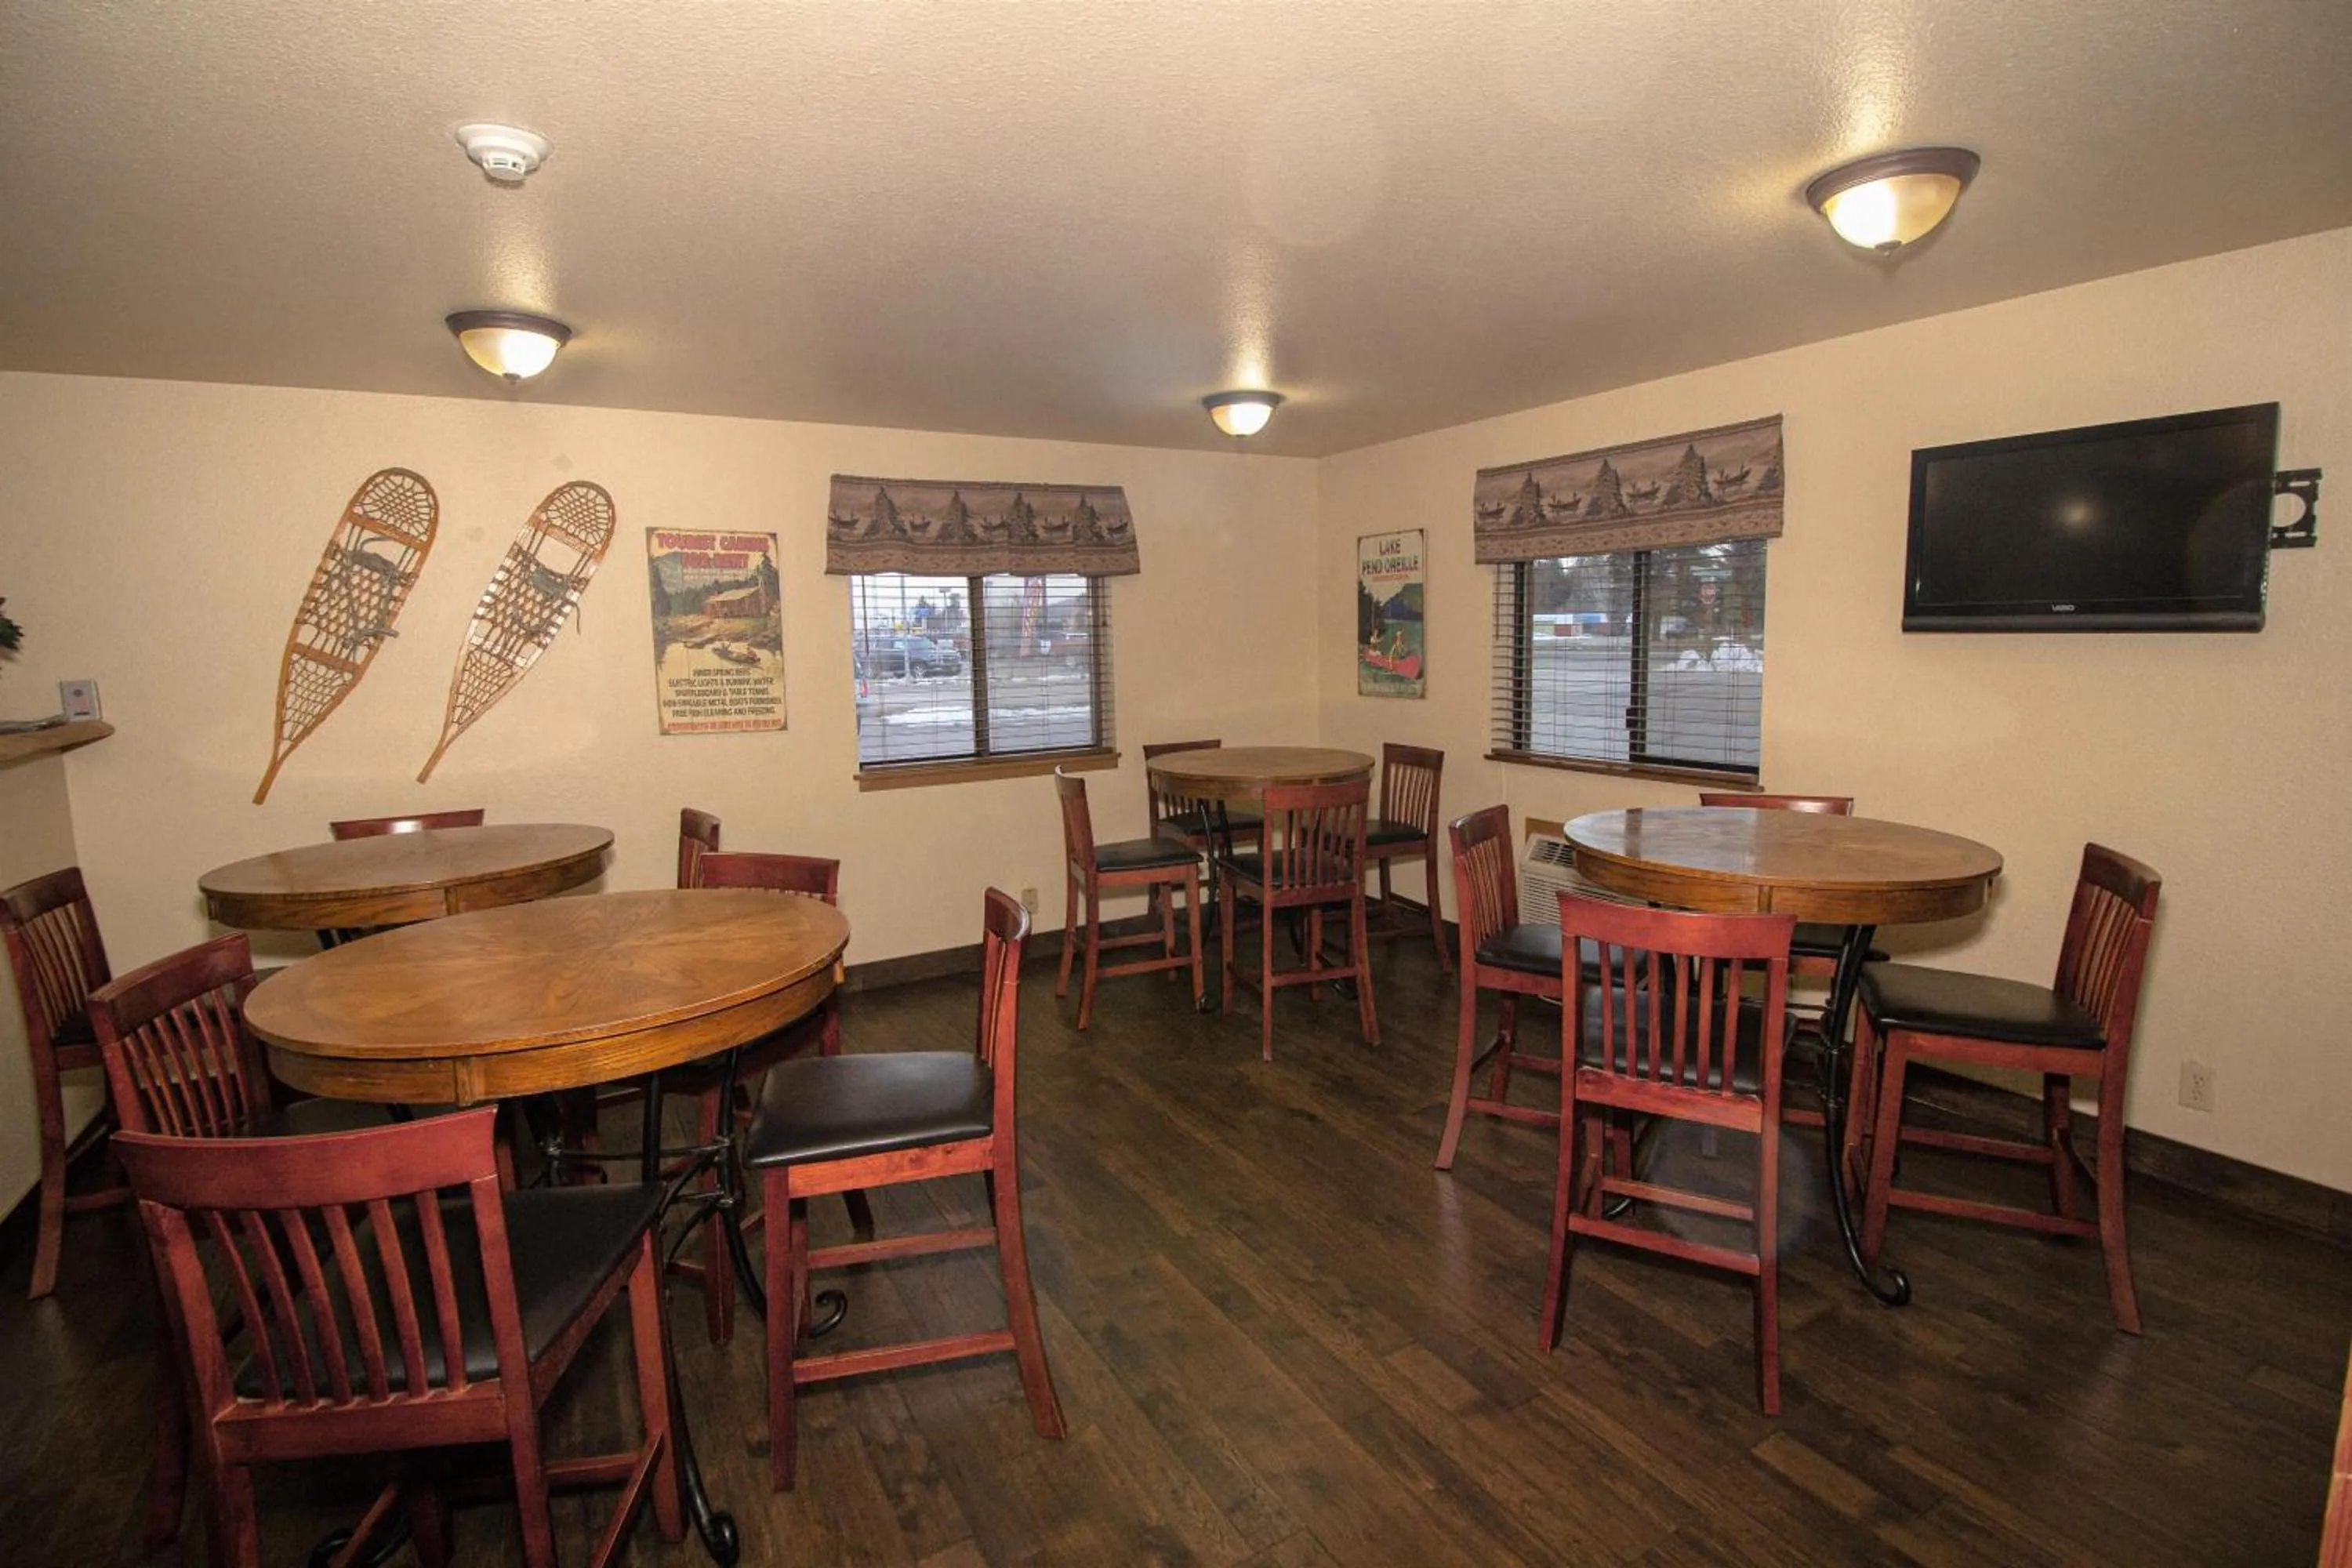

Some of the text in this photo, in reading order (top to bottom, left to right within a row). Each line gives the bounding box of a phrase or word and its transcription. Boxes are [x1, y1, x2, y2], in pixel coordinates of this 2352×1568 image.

[1379, 539, 1401, 556] LAKE
[1362, 555, 1418, 575] PEND OREILLE
